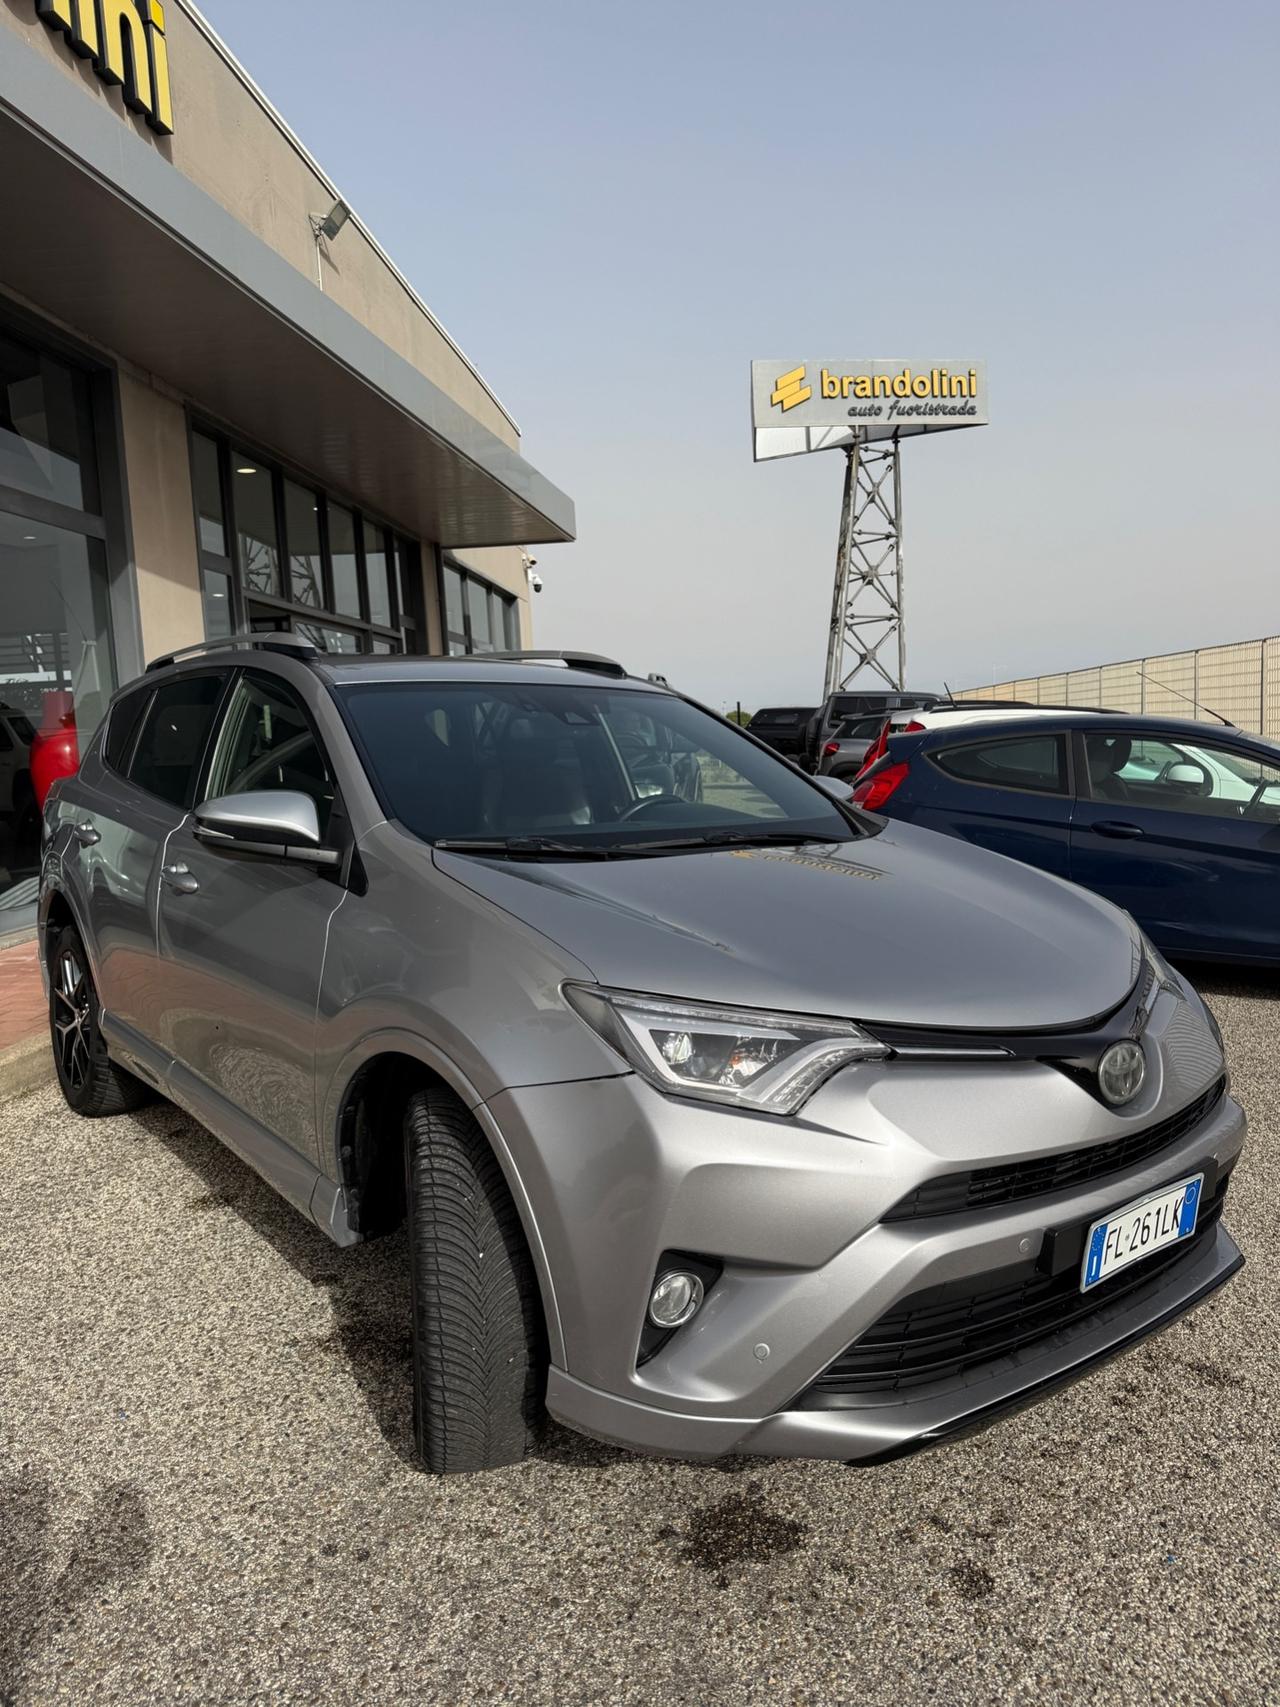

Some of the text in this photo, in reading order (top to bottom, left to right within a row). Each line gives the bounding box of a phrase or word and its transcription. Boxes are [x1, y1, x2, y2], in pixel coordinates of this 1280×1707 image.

[820, 368, 977, 398] brandolini
[847, 399, 977, 421] auto fuoristrada
